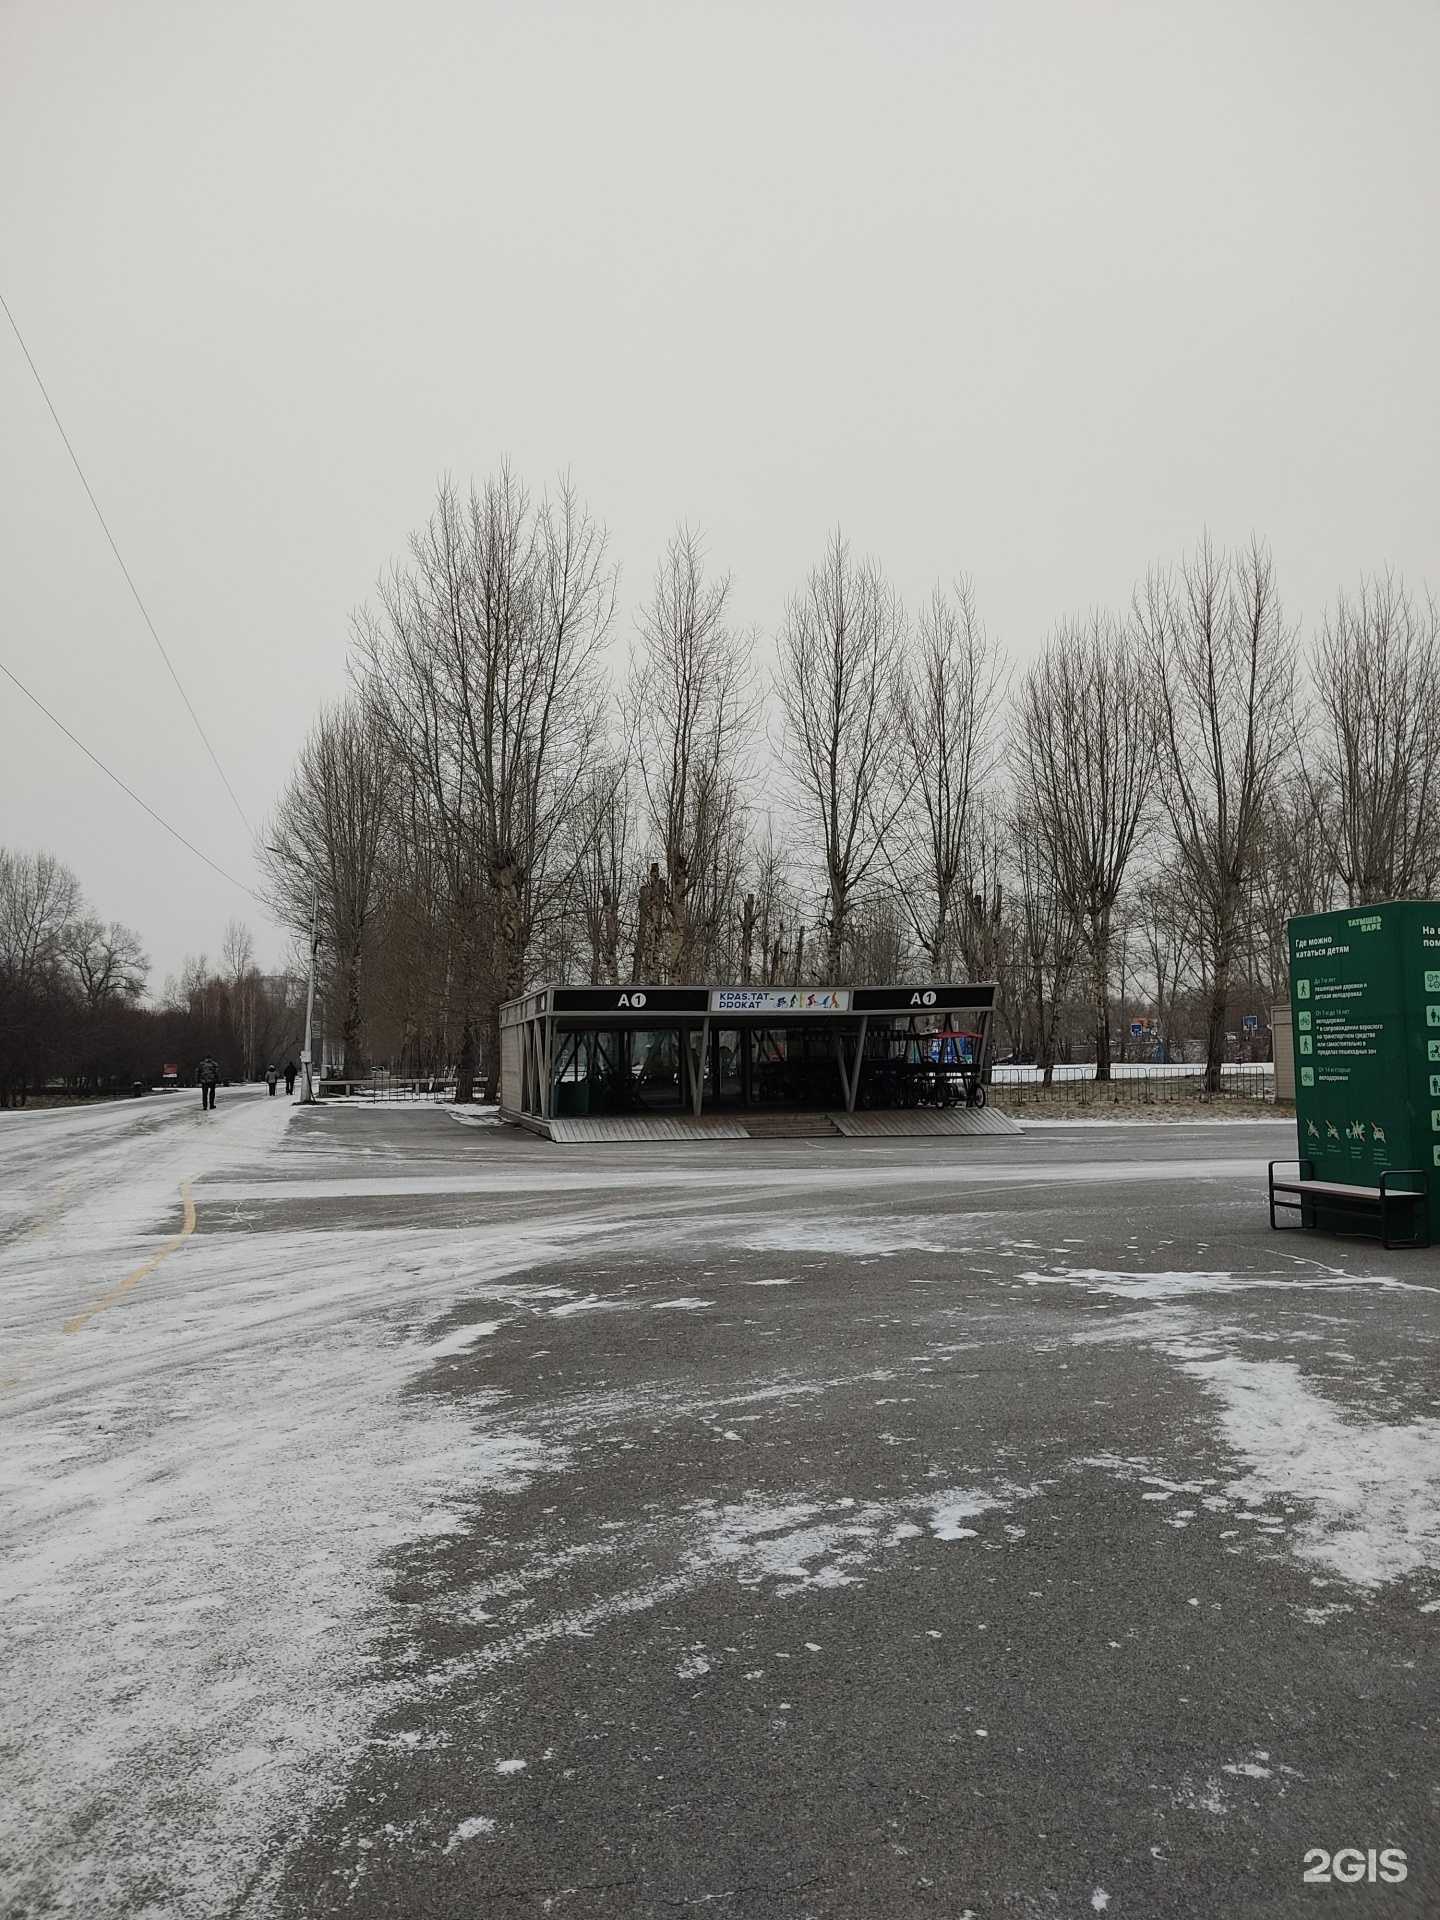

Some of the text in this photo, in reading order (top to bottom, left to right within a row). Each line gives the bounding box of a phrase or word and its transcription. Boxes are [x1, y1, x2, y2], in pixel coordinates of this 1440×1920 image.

[1348, 915, 1382, 927] ТАТЫШЕВ
[1361, 923, 1382, 933] ПАРК
[1422, 925, 1435, 935] На
[1295, 936, 1333, 949] Где можно
[1295, 945, 1350, 958] кататься детям
[719, 1001, 761, 1009] PROKAT
